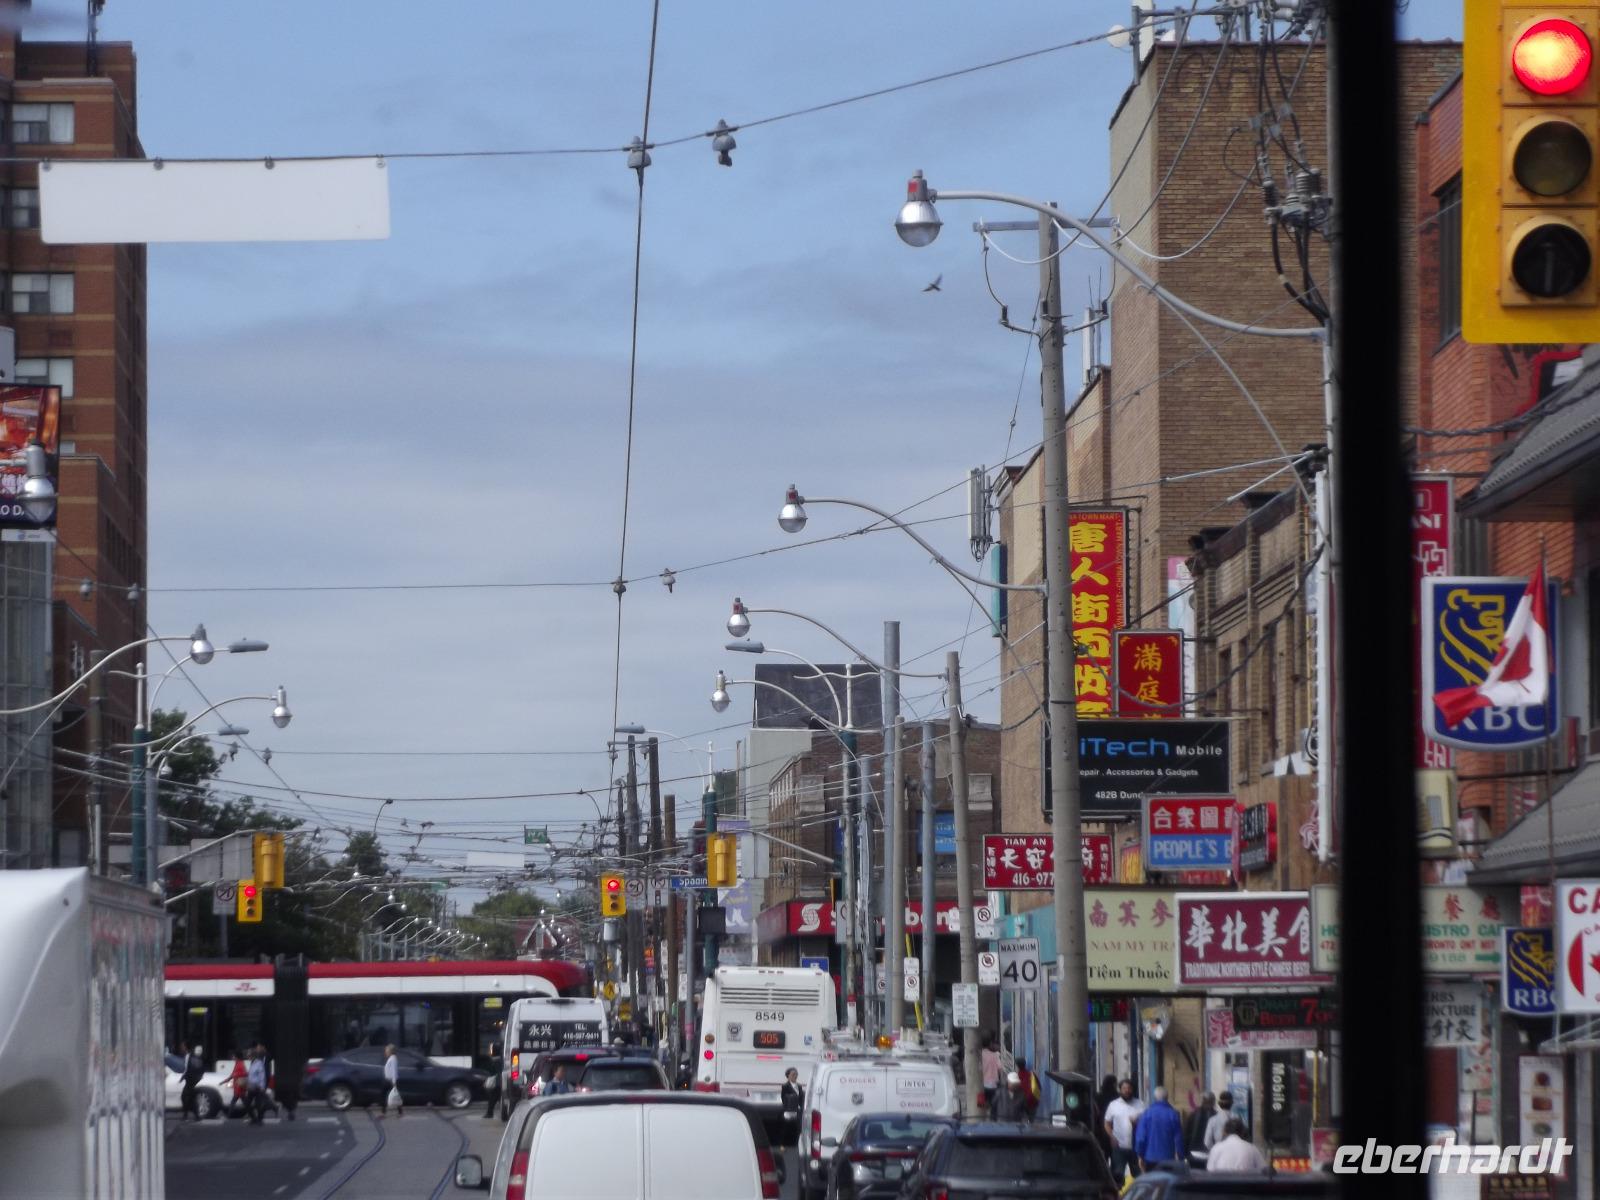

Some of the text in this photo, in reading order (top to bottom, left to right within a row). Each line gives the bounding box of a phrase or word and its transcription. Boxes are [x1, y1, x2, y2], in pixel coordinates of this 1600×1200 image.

[1176, 745, 1222, 756] Mobile
[1106, 768, 1155, 776] Accessories
[1165, 769, 1198, 778] Gadgets
[1095, 791, 1118, 799] 482B
[1005, 838, 1027, 846] TIAN
[1033, 838, 1046, 846] AN
[1154, 838, 1218, 859] PEOPLE'S
[679, 876, 708, 889] Spadin
[1001, 943, 1036, 952] MAXIMUM
[1003, 960, 1037, 982] 40
[755, 1012, 785, 1021] 8549
[574, 1023, 588, 1031] TEL:
[760, 1033, 778, 1044] 505
[1272, 1063, 1286, 1111] Mobile
